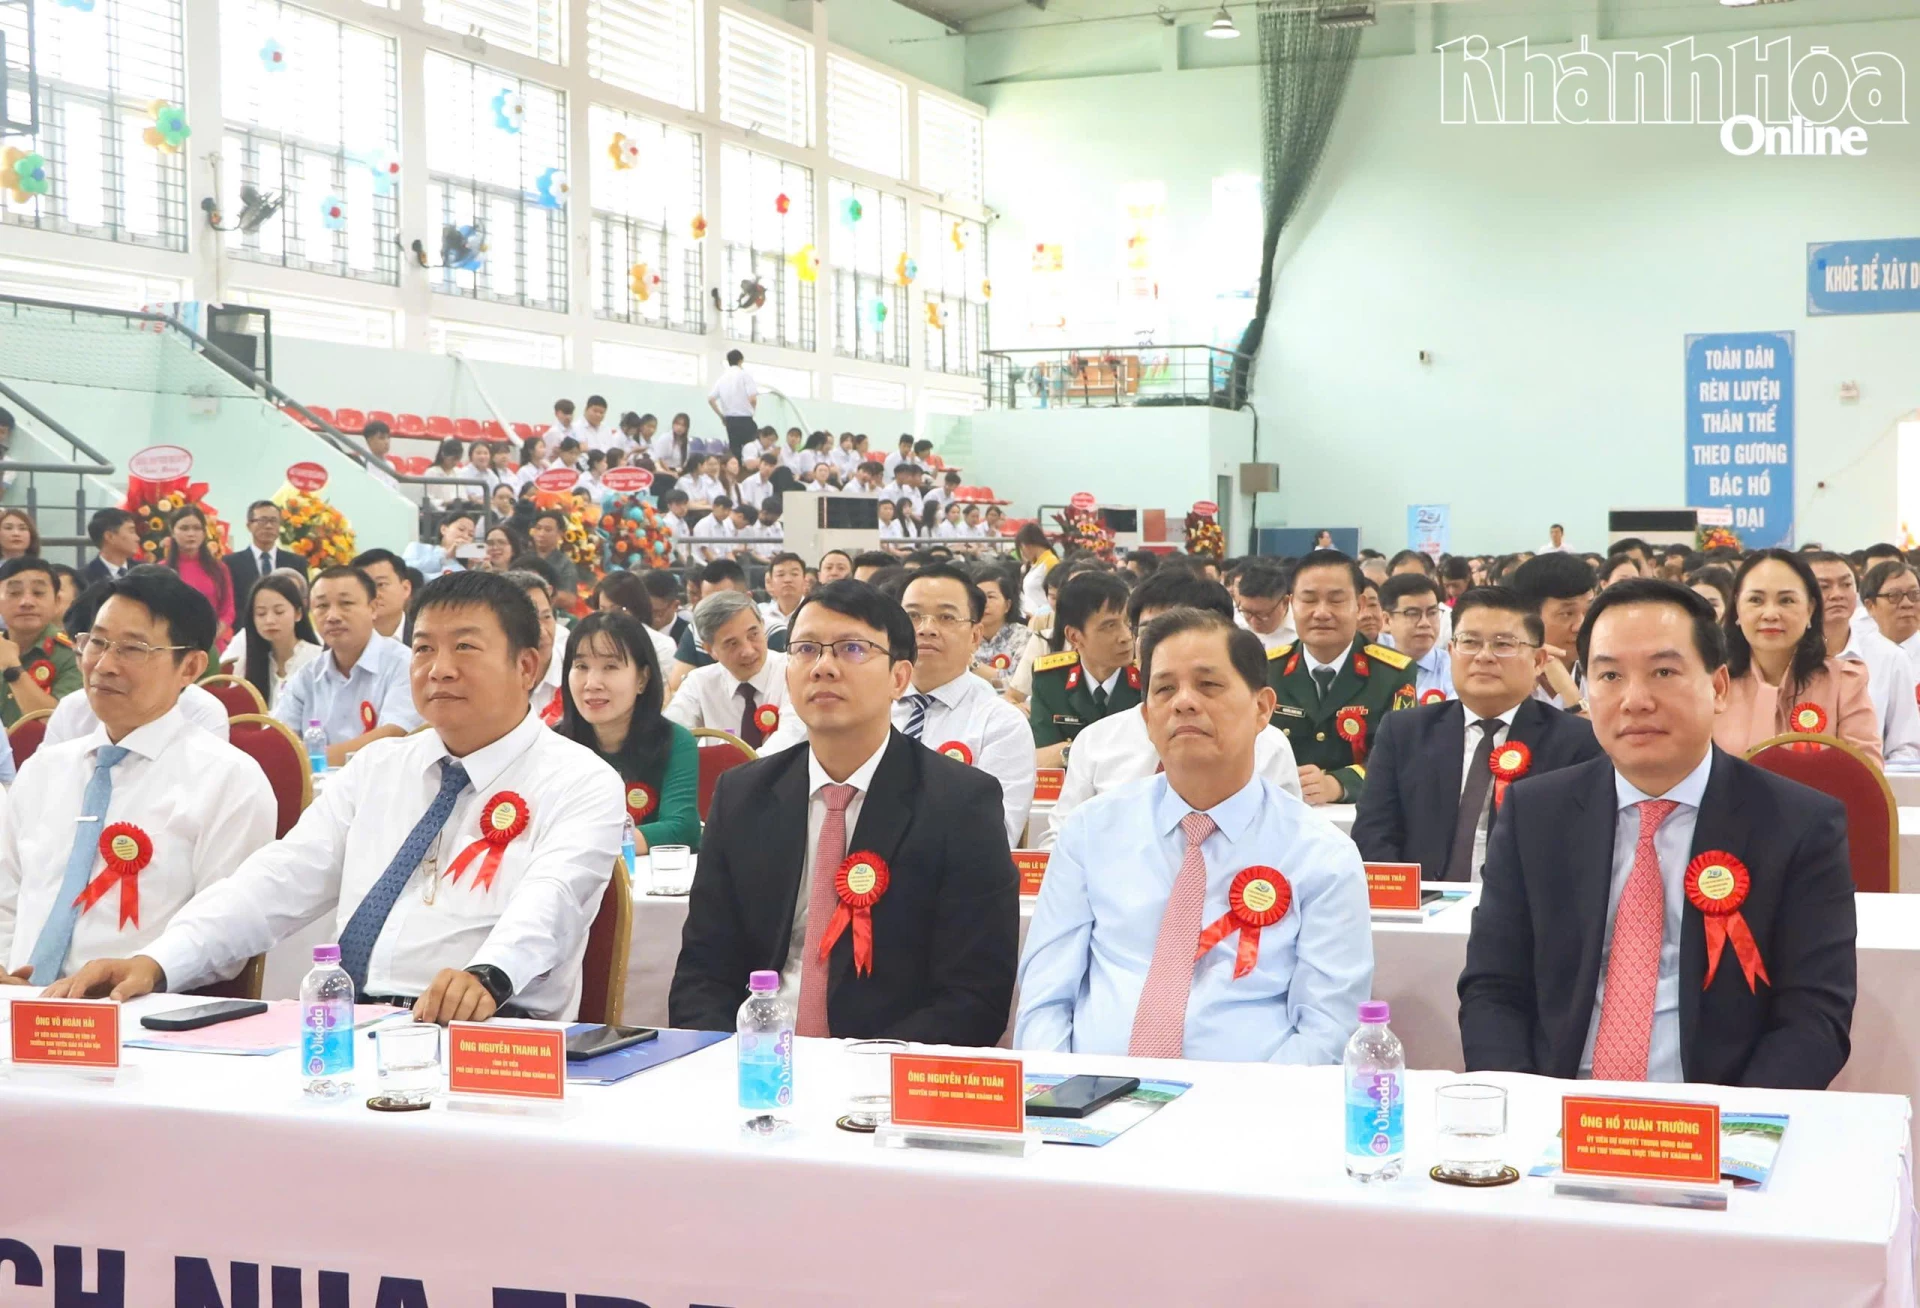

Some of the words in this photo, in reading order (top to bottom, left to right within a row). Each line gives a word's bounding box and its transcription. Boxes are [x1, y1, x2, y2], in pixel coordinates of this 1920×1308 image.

[1825, 255, 1859, 292] KHỎE
[1861, 252, 1879, 291] ĐỂ
[1881, 257, 1907, 290] XÂY
[1705, 346, 1741, 370] TOÀN
[1744, 345, 1774, 369] DÂN
[1700, 378, 1729, 402] RÈN
[1733, 376, 1780, 405] LUYỆN
[1702, 409, 1743, 433] THÂN
[1747, 404, 1777, 433] THỂ
[1692, 444, 1730, 465] THEO
[1734, 442, 1788, 465] GƯƠNG
[1709, 472, 1743, 496] BÁC
[1747, 469, 1771, 496] HỒ
[1736, 507, 1765, 532] ĐẠI
[1018, 860, 1031, 869] ÔNG
[35, 1015, 50, 1026] ÔNG
[311, 1009, 324, 1054] Vikoda
[460, 1039, 477, 1052] ÔNG
[478, 1040, 510, 1054] NGUYỄN
[512, 1044, 539, 1056] THANH
[778, 1033, 791, 1082] Vikoda
[907, 1070, 925, 1083] ÔNG
[927, 1071, 961, 1085] NGUYỄN
[963, 1072, 980, 1086] TẤN
[1373, 1077, 1389, 1131] Vikoda
[1580, 1113, 1603, 1128] ÔNG
[1605, 1114, 1620, 1129] HỒ
[1623, 1117, 1653, 1131] XUÂN
[1656, 1119, 1700, 1135] TRƯỜNG
